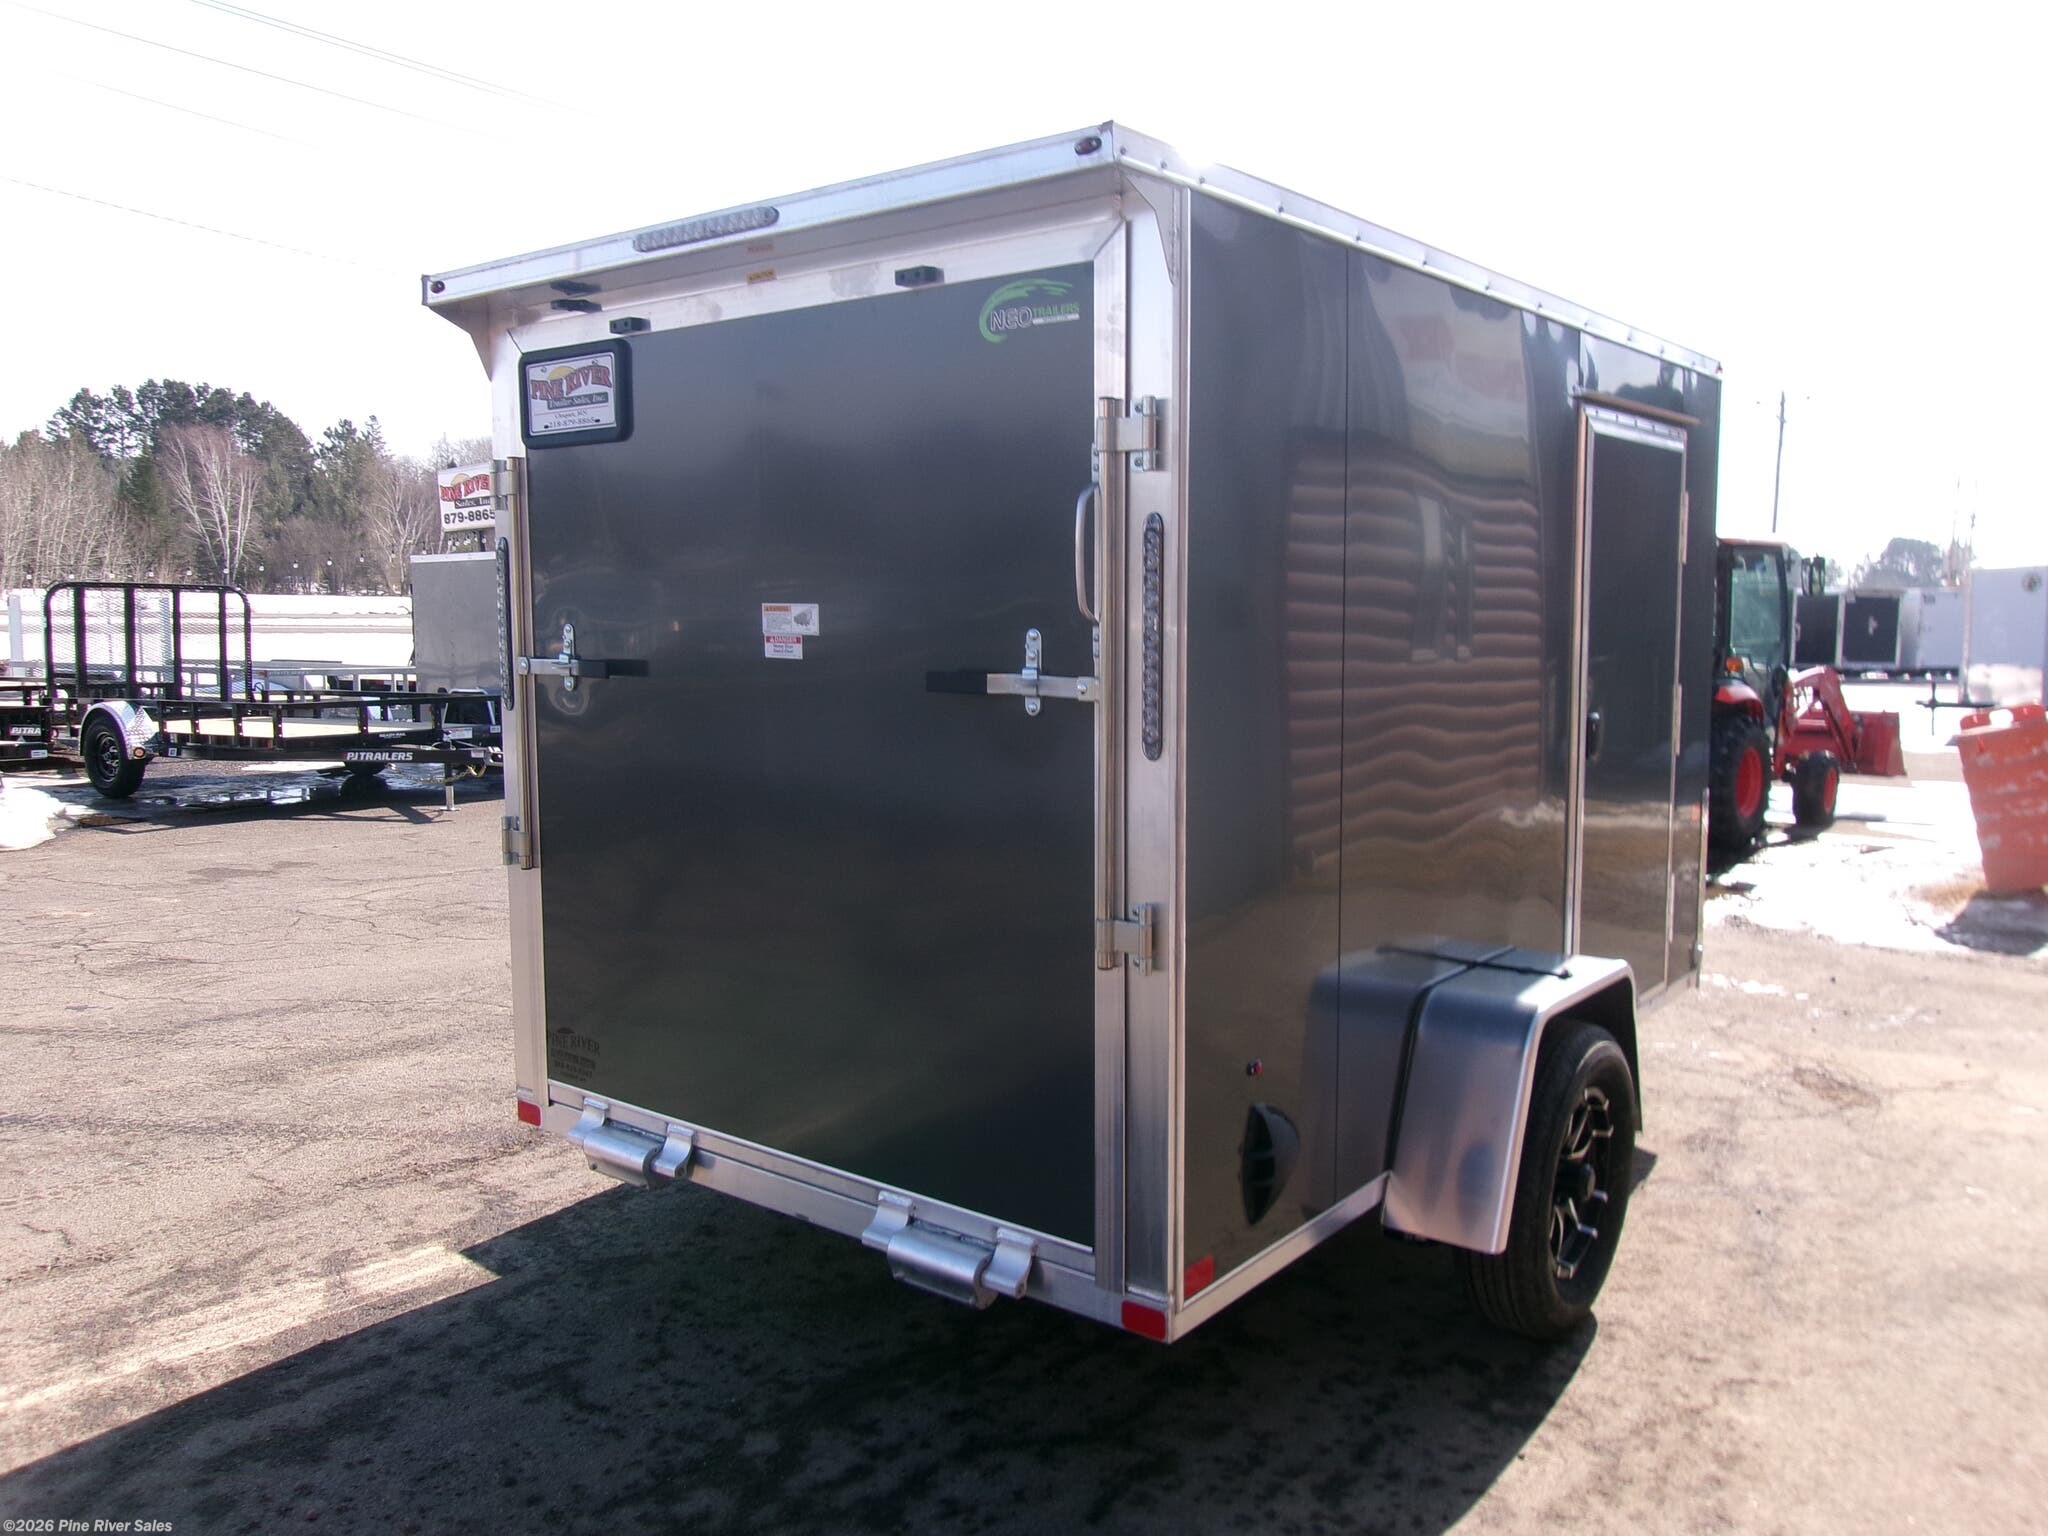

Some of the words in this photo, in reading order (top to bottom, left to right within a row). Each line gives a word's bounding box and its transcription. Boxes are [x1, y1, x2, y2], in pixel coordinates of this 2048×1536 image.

[531, 378, 564, 401] PINE
[566, 364, 612, 396] RIVER
[444, 509, 495, 525] 879-8865
